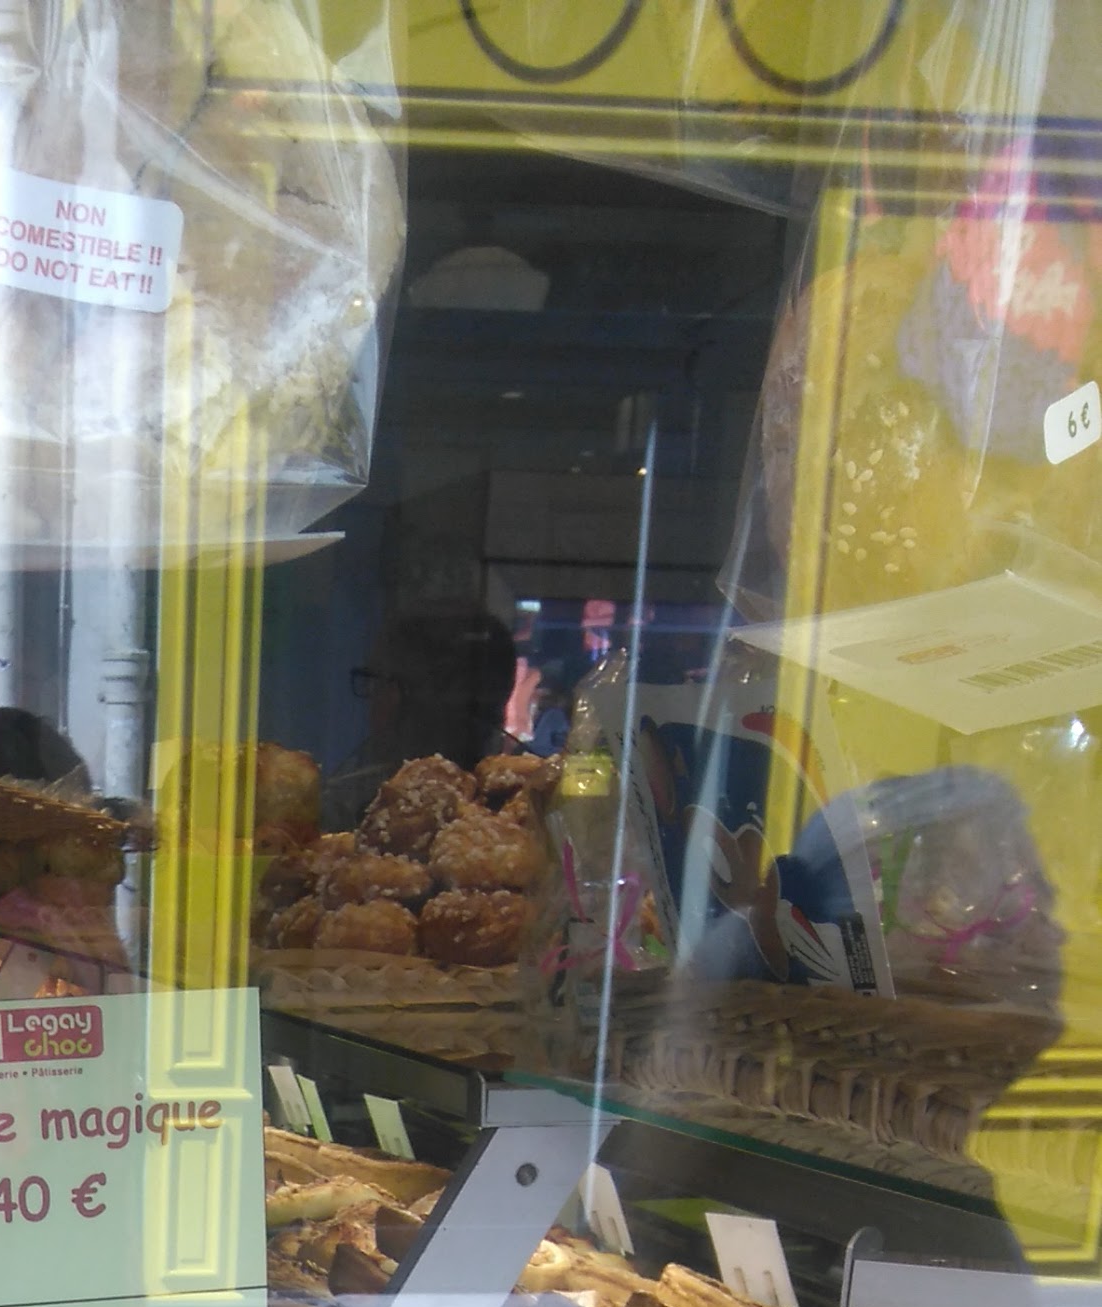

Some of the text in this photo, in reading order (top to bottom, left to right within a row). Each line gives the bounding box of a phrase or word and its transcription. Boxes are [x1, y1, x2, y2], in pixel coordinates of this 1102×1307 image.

[55, 199, 106, 226] NON
[34, 256, 83, 283] NOT
[89, 267, 135, 291] EAT
[1068, 402, 1091, 438] 6 €
[7, 1011, 92, 1035] Legay
[24, 1031, 93, 1057] choc
[31, 1066, 84, 1078] Pâtisserie
[40, 1092, 223, 1149] magique
[71, 1172, 107, 1218] €
